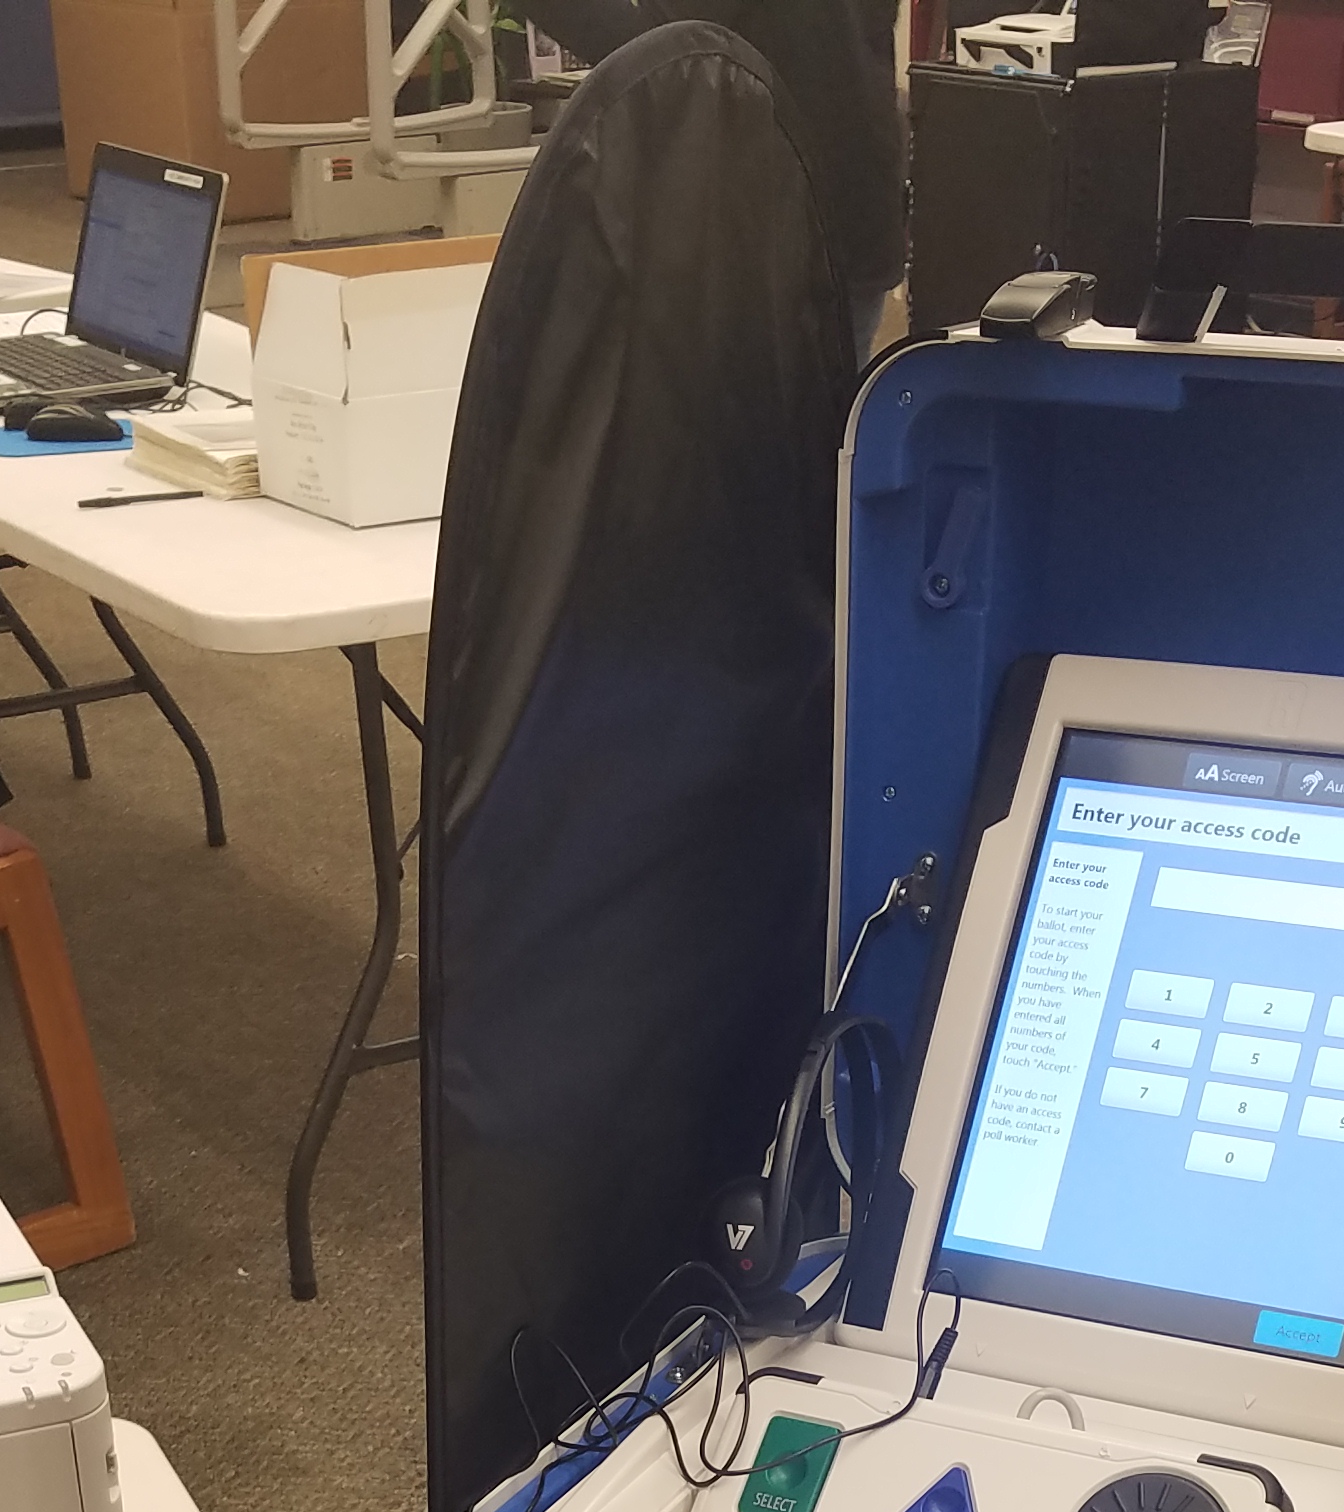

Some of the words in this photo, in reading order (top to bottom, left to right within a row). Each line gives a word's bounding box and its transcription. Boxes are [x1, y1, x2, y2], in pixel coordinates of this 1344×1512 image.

[1221, 769, 1264, 785] Screen
[1071, 803, 1124, 825] Enter
[1127, 811, 1176, 831] your
[1181, 820, 1245, 839] access
[1251, 826, 1301, 845] code
[1052, 858, 1080, 870] Enter
[1082, 863, 1107, 873] your
[1048, 875, 1081, 886] access
[1084, 880, 1109, 889] code
[1042, 903, 1053, 914] To
[1056, 906, 1078, 918] start
[1080, 911, 1103, 921] your
[1070, 926, 1096, 935] enter
[1032, 935, 1055, 946] your
[1058, 940, 1088, 950] access
[1029, 951, 1053, 960] code
[1056, 952, 1069, 964] by
[1026, 965, 1068, 980] touching
[1071, 969, 1087, 981] the
[1021, 980, 1066, 994] numbers.
[1073, 986, 1101, 999] When
[1164, 989, 1173, 1002] 1
[1017, 995, 1036, 1006] you
[1038, 996, 1062, 1009] have
[1263, 1002, 1273, 1015] 2
[1014, 1011, 1052, 1024] entered
[1053, 1014, 1066, 1025] all
[1010, 1025, 1053, 1039] numbers
[1055, 1031, 1067, 1041] of
[1005, 1041, 1029, 1051] your
[1031, 1043, 1056, 1056] code,
[1151, 1039, 1161, 1051] 4
[1002, 1055, 1030, 1067] touch
[1250, 1052, 1260, 1065] 5
[994, 1084, 1004, 1094] If
[1004, 1086, 1023, 1098] you
[1025, 1089, 1038, 1099] do
[1040, 1093, 1057, 1103] not
[1139, 1086, 1149, 1098] 7
[991, 1099, 1014, 1111] have
[1016, 1106, 1029, 1114] an
[1031, 1109, 1062, 1119] access
[1238, 1101, 1247, 1114] 8
[987, 1115, 1013, 1128] code,
[1015, 1121, 1052, 1134] contact
[1053, 1126, 1061, 1135] a
[983, 1129, 1003, 1140] poll
[1225, 1151, 1234, 1164] 0
[726, 1223, 755, 1250] V7
[1275, 1325, 1321, 1344] Accept
[753, 1492, 797, 1512] SELECT
